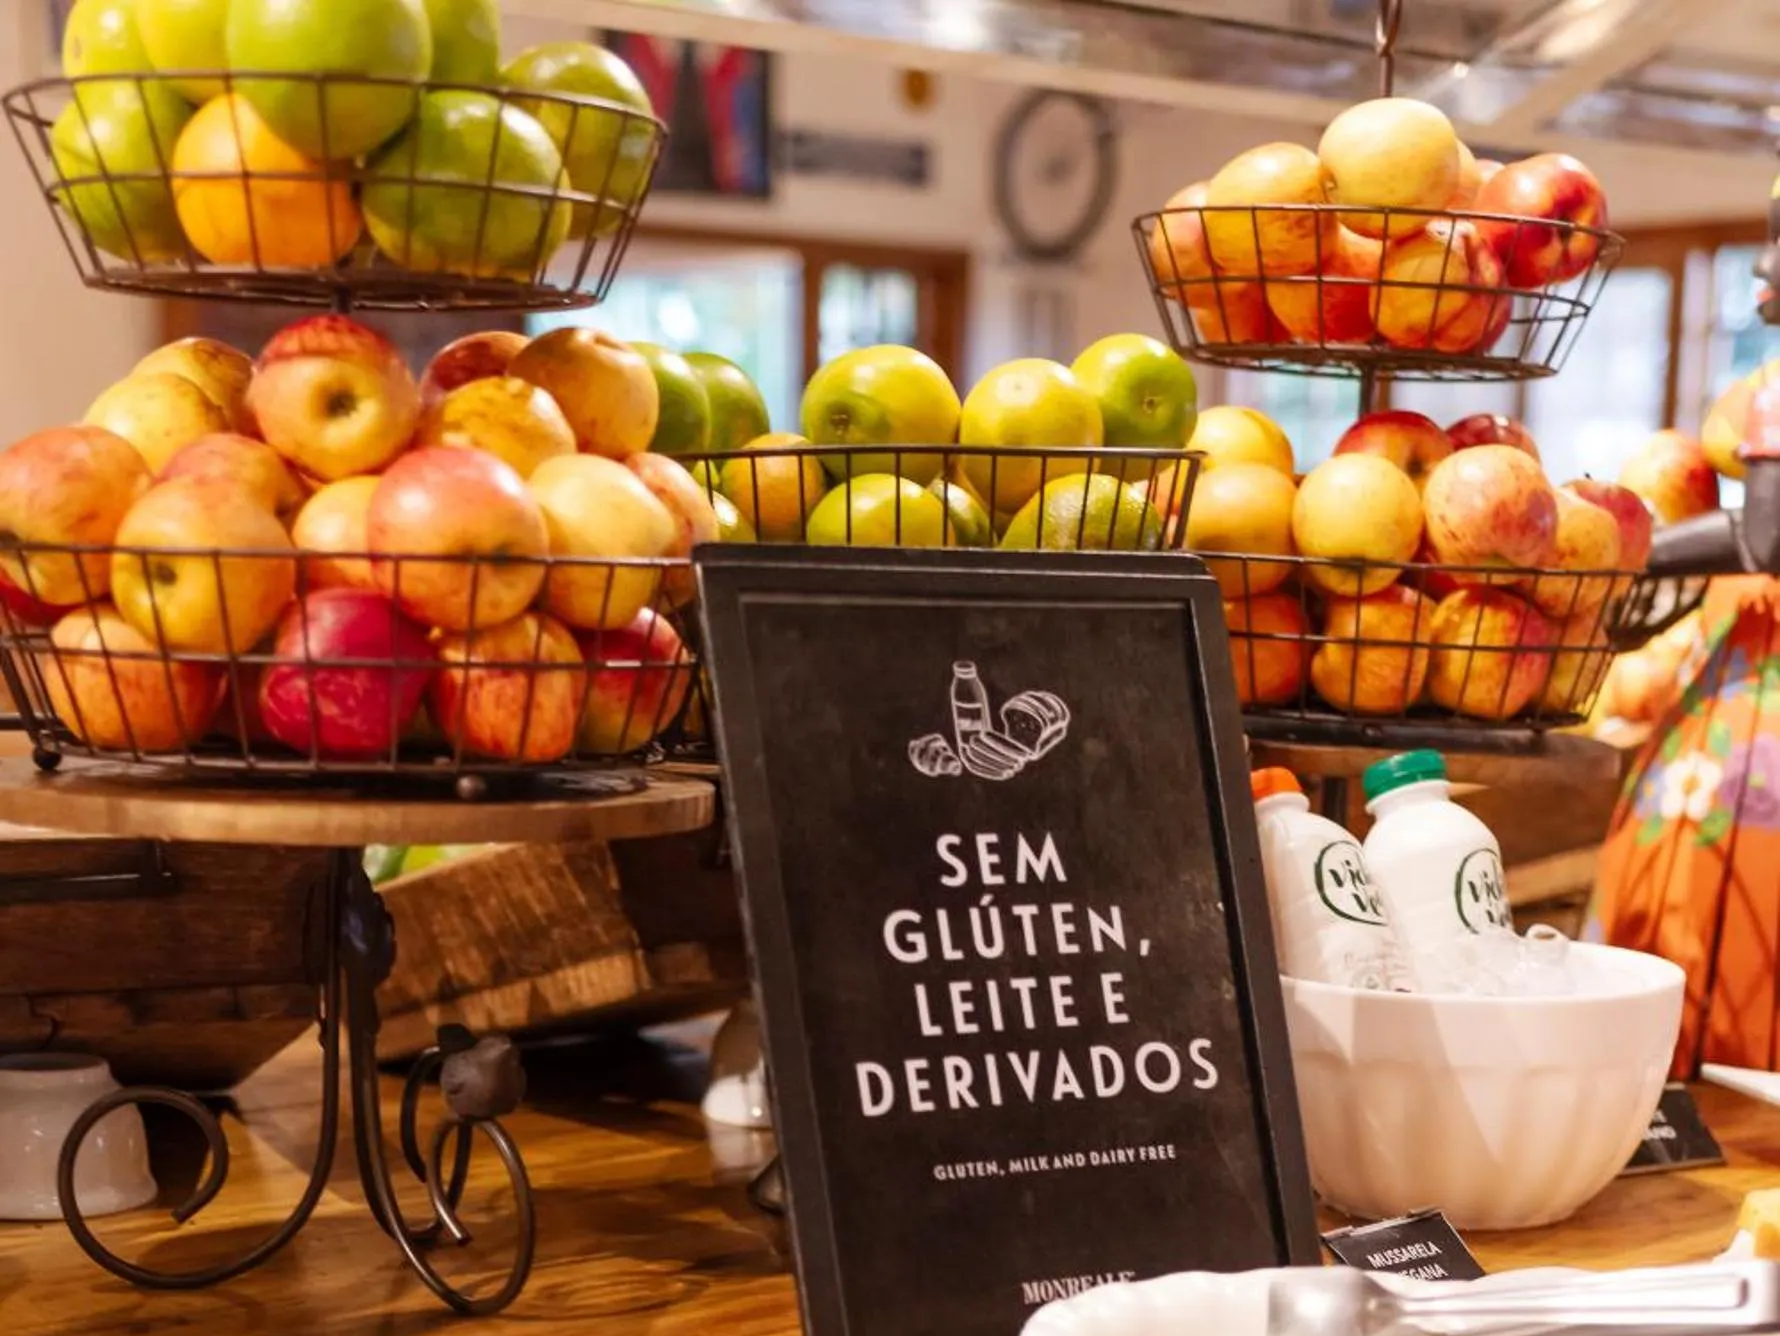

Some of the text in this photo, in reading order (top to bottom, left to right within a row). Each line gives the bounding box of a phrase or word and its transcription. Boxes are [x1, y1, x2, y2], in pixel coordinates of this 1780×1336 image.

[936, 831, 1067, 887] SEM
[883, 893, 1151, 963] GLÚTEN,
[914, 972, 1130, 1037] LEITE E
[855, 1037, 1219, 1117] DERIVADOS
[933, 1143, 1177, 1181] GLUTEN, MILK AND DAIRY FREE
[1366, 1240, 1443, 1269] MUSSARELA
